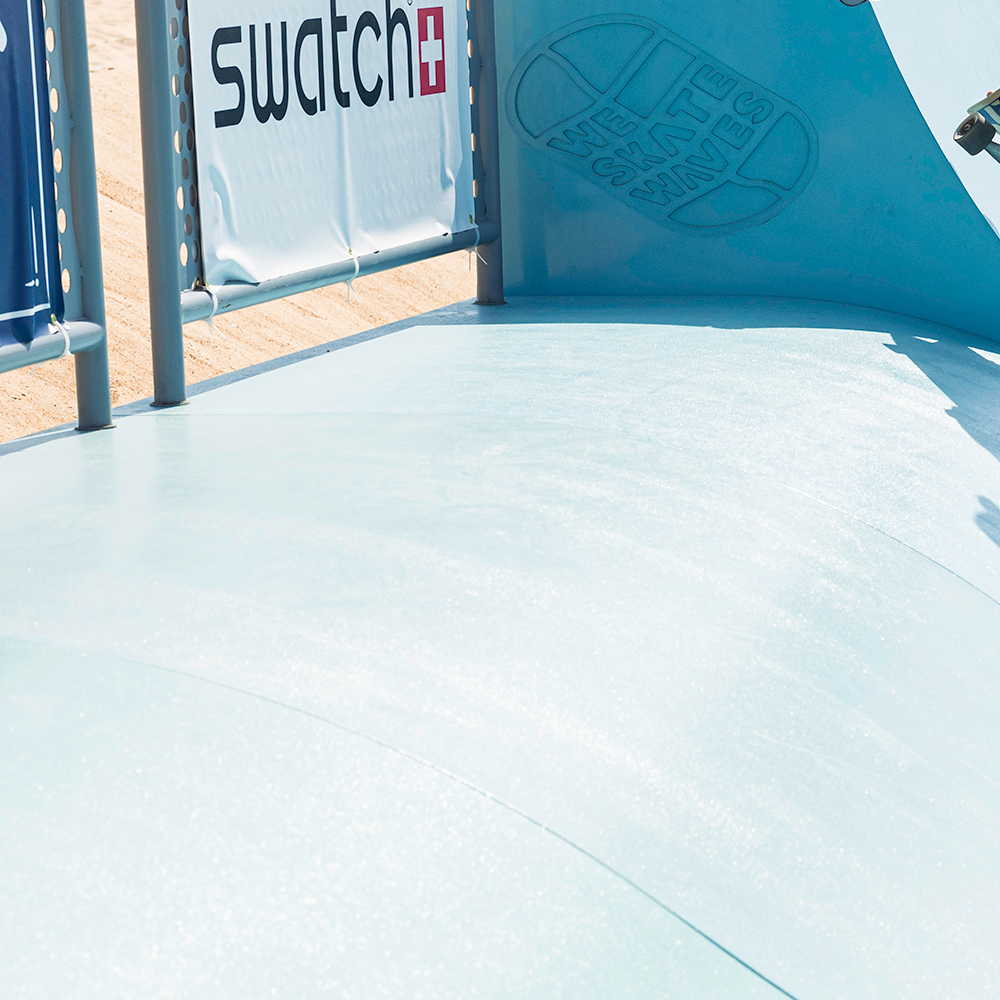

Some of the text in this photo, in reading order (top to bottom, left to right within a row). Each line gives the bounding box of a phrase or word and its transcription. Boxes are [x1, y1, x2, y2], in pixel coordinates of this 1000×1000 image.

[547, 107, 639, 158] WE
[592, 63, 739, 186] SKATE
[629, 91, 774, 206] WAVES
